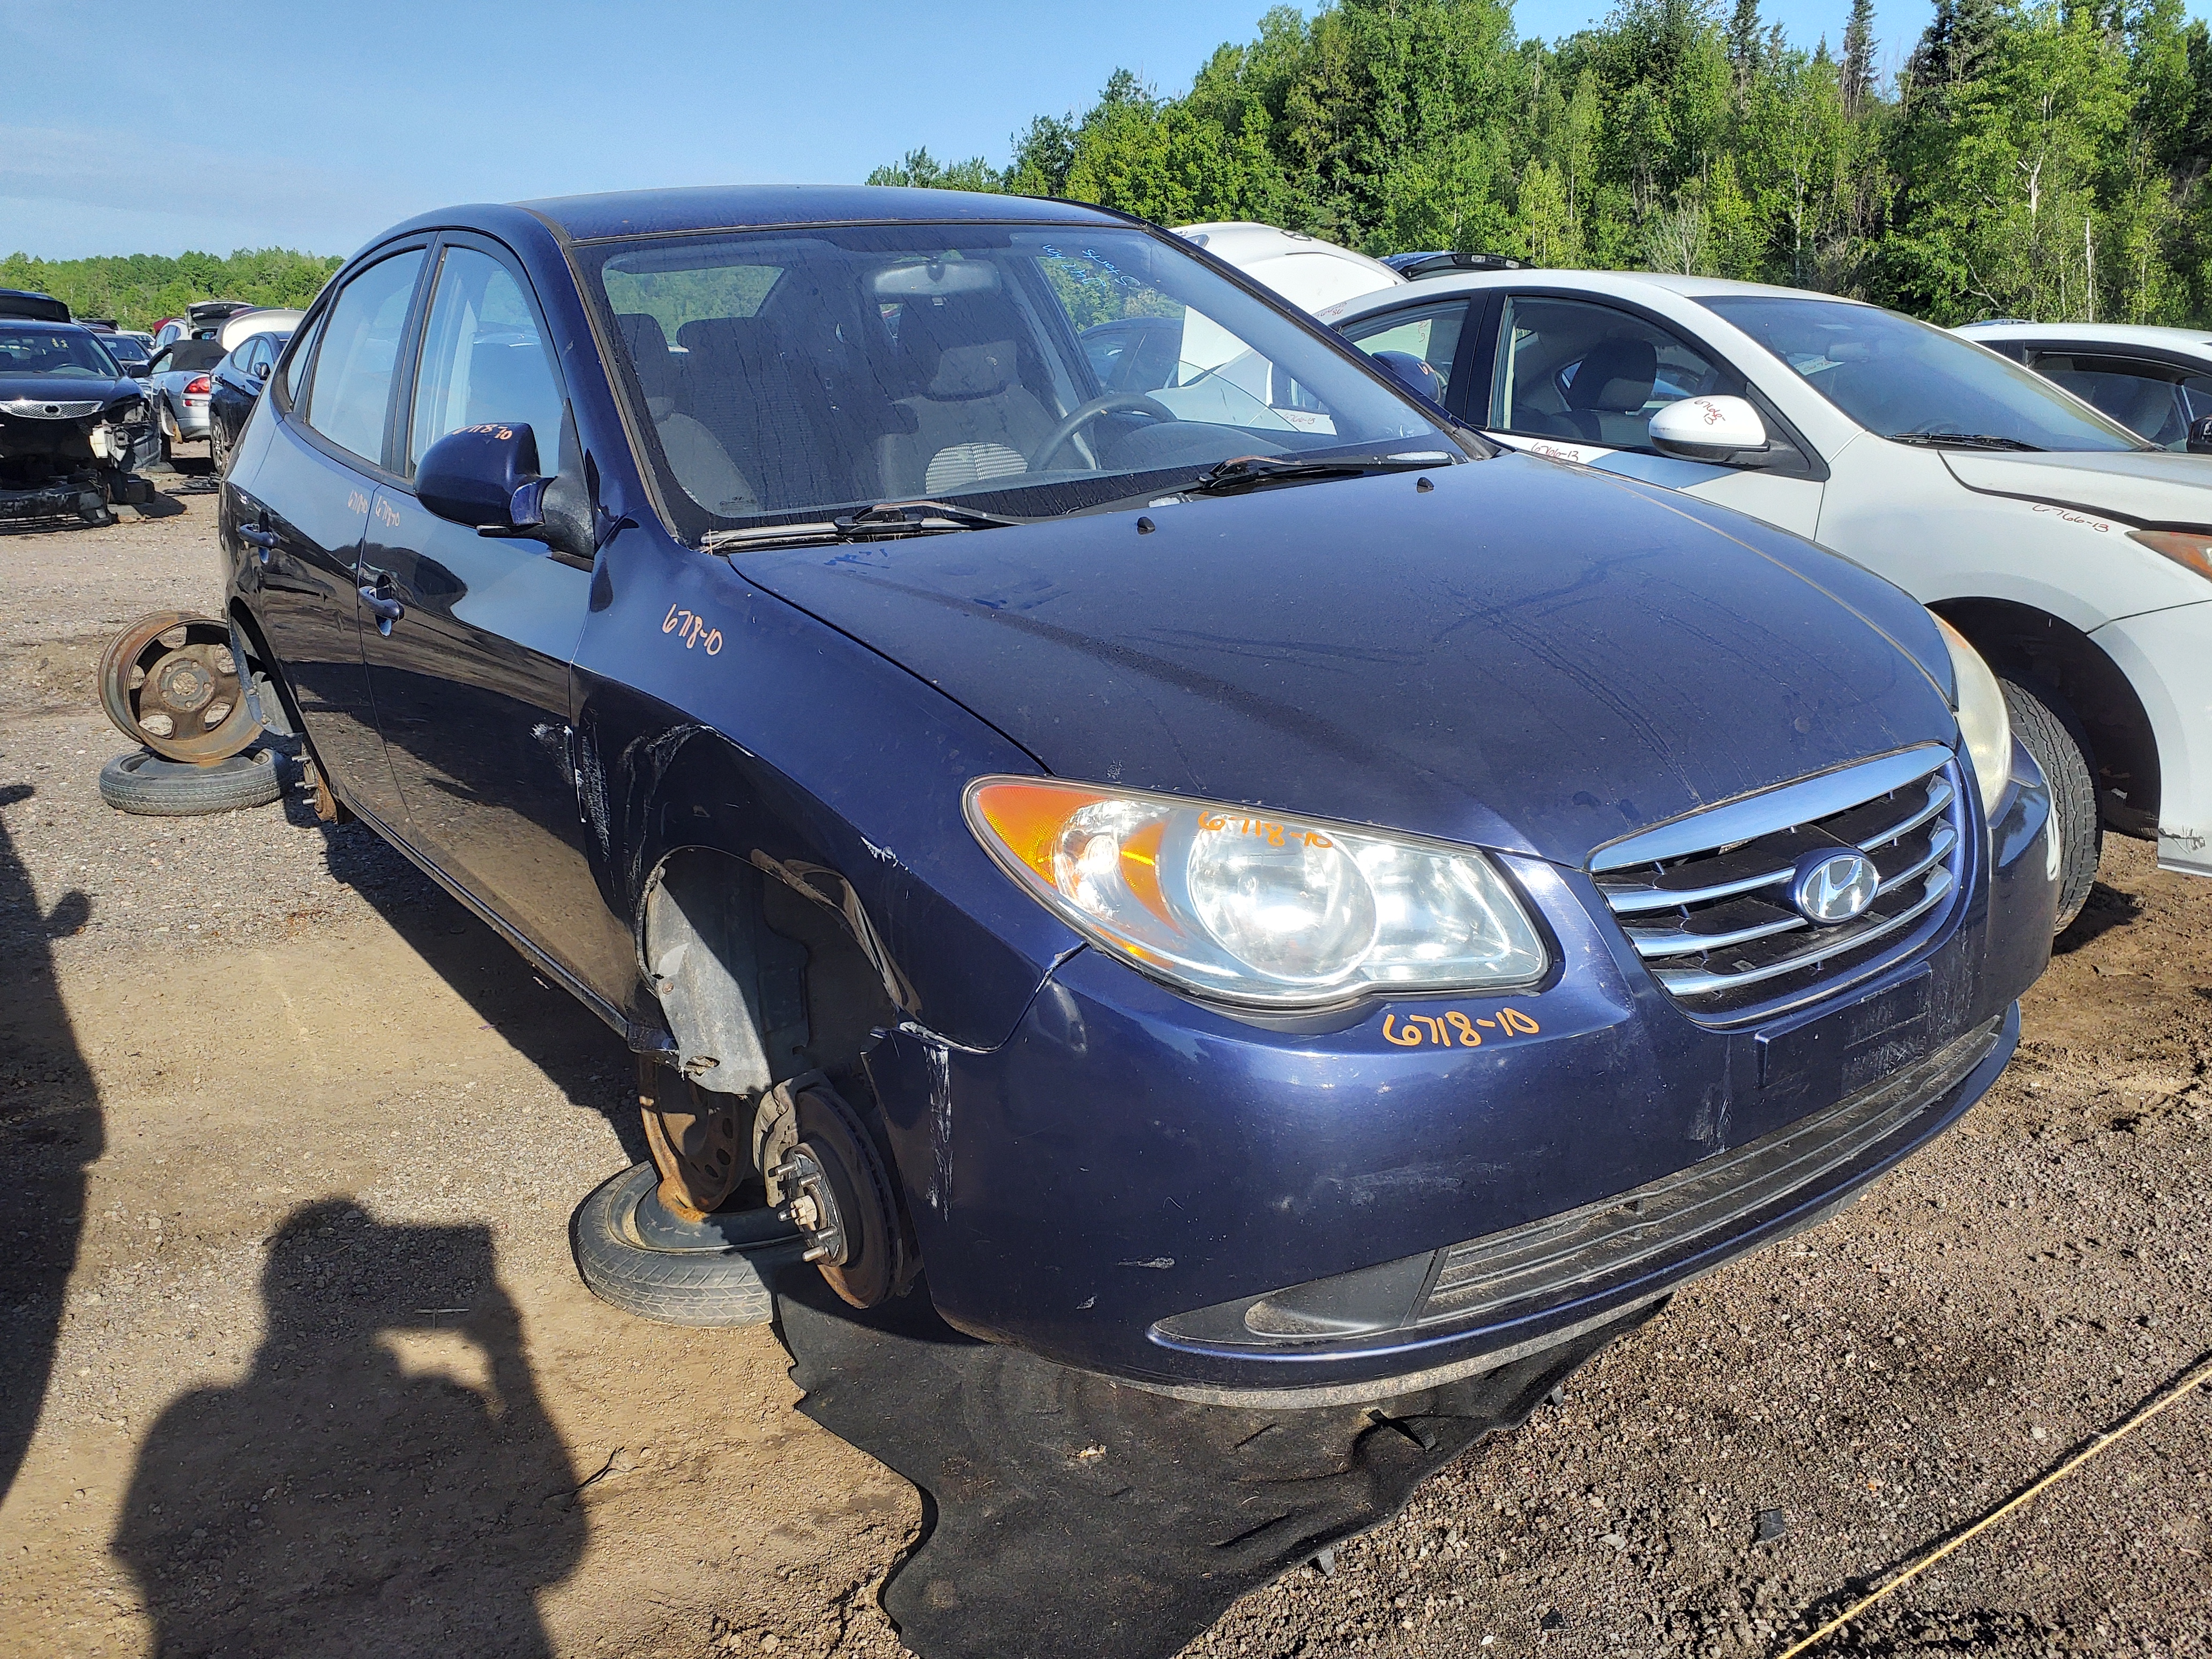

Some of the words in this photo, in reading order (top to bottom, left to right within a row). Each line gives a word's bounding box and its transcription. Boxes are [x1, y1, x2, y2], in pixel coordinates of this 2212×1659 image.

[1531, 442, 1579, 462] 6766-13
[2032, 504, 2109, 533] 6766-13
[662, 603, 723, 656] 6718-10
[1197, 811, 1334, 849] 6718-10
[1382, 1007, 1541, 1047] 6718-10
